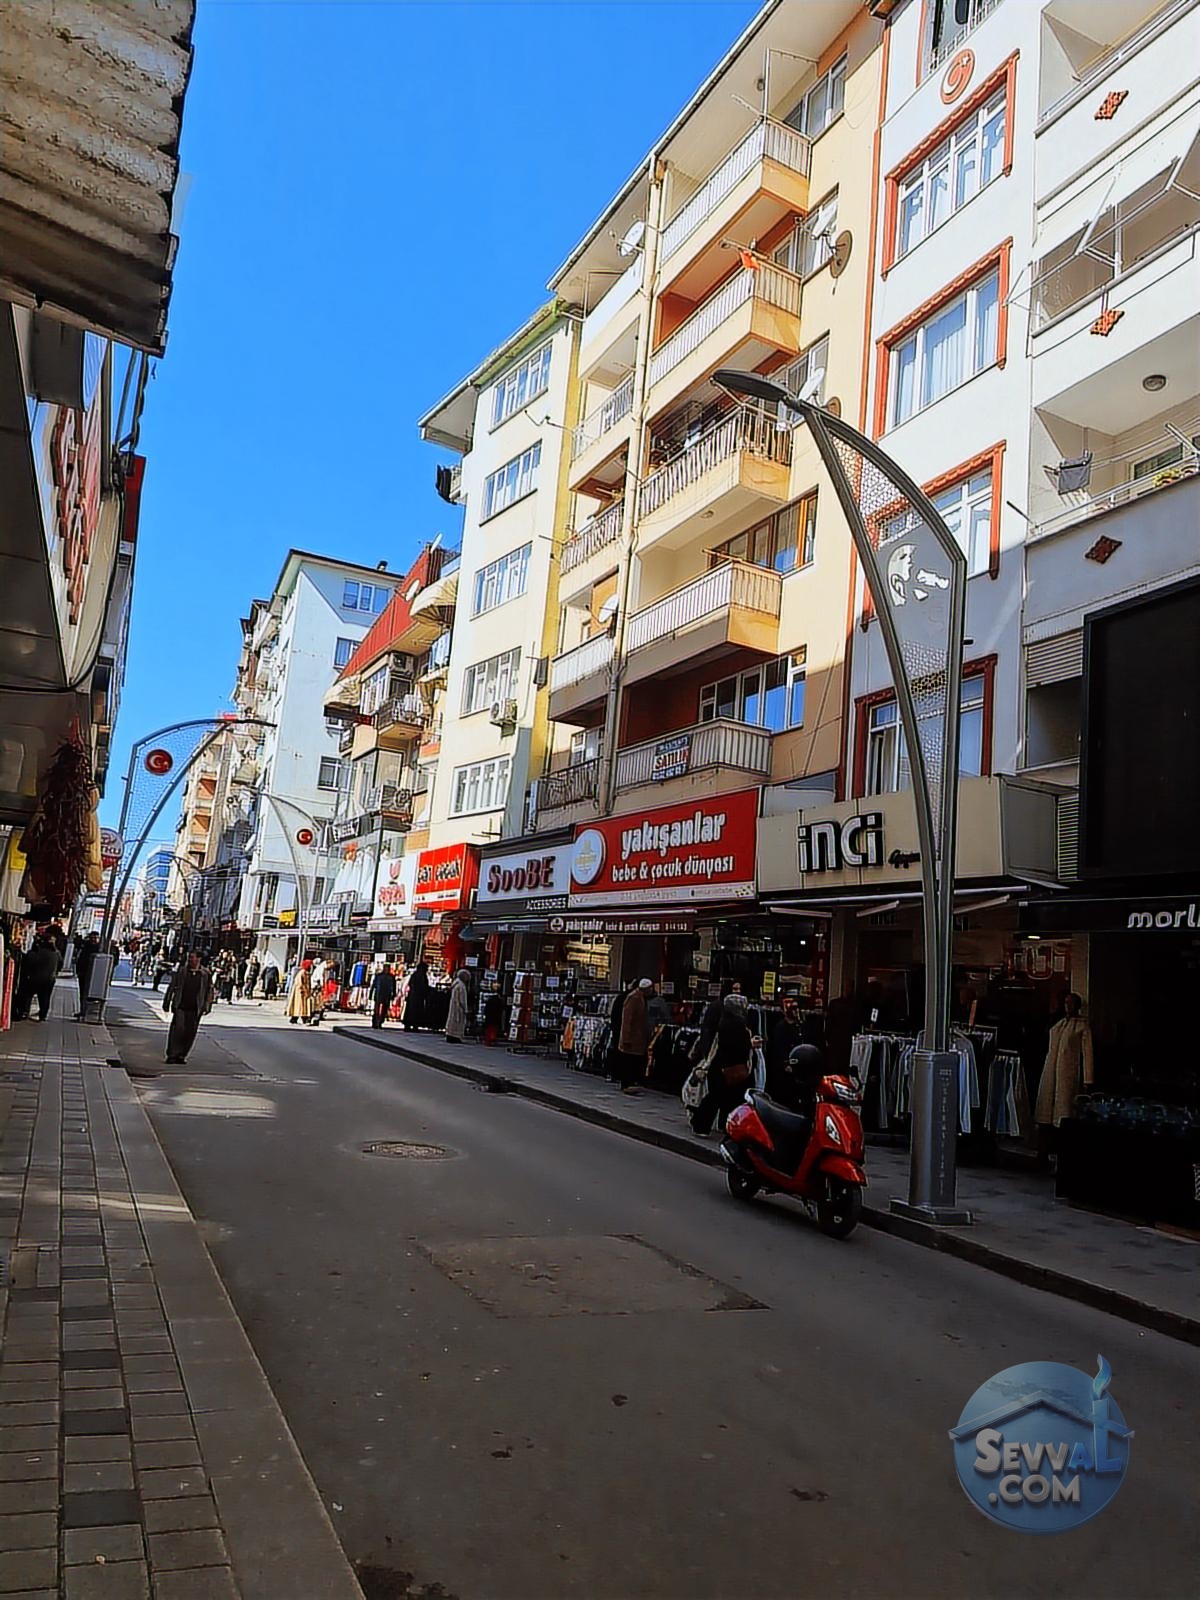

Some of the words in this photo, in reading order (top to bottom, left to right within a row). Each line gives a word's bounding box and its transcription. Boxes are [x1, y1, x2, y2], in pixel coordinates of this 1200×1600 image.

[621, 810, 726, 860] yakışanlar
[612, 864, 637, 882] bebe
[639, 861, 649, 880] &
[651, 857, 682, 884] çocuk
[684, 855, 734, 879] dünyası
